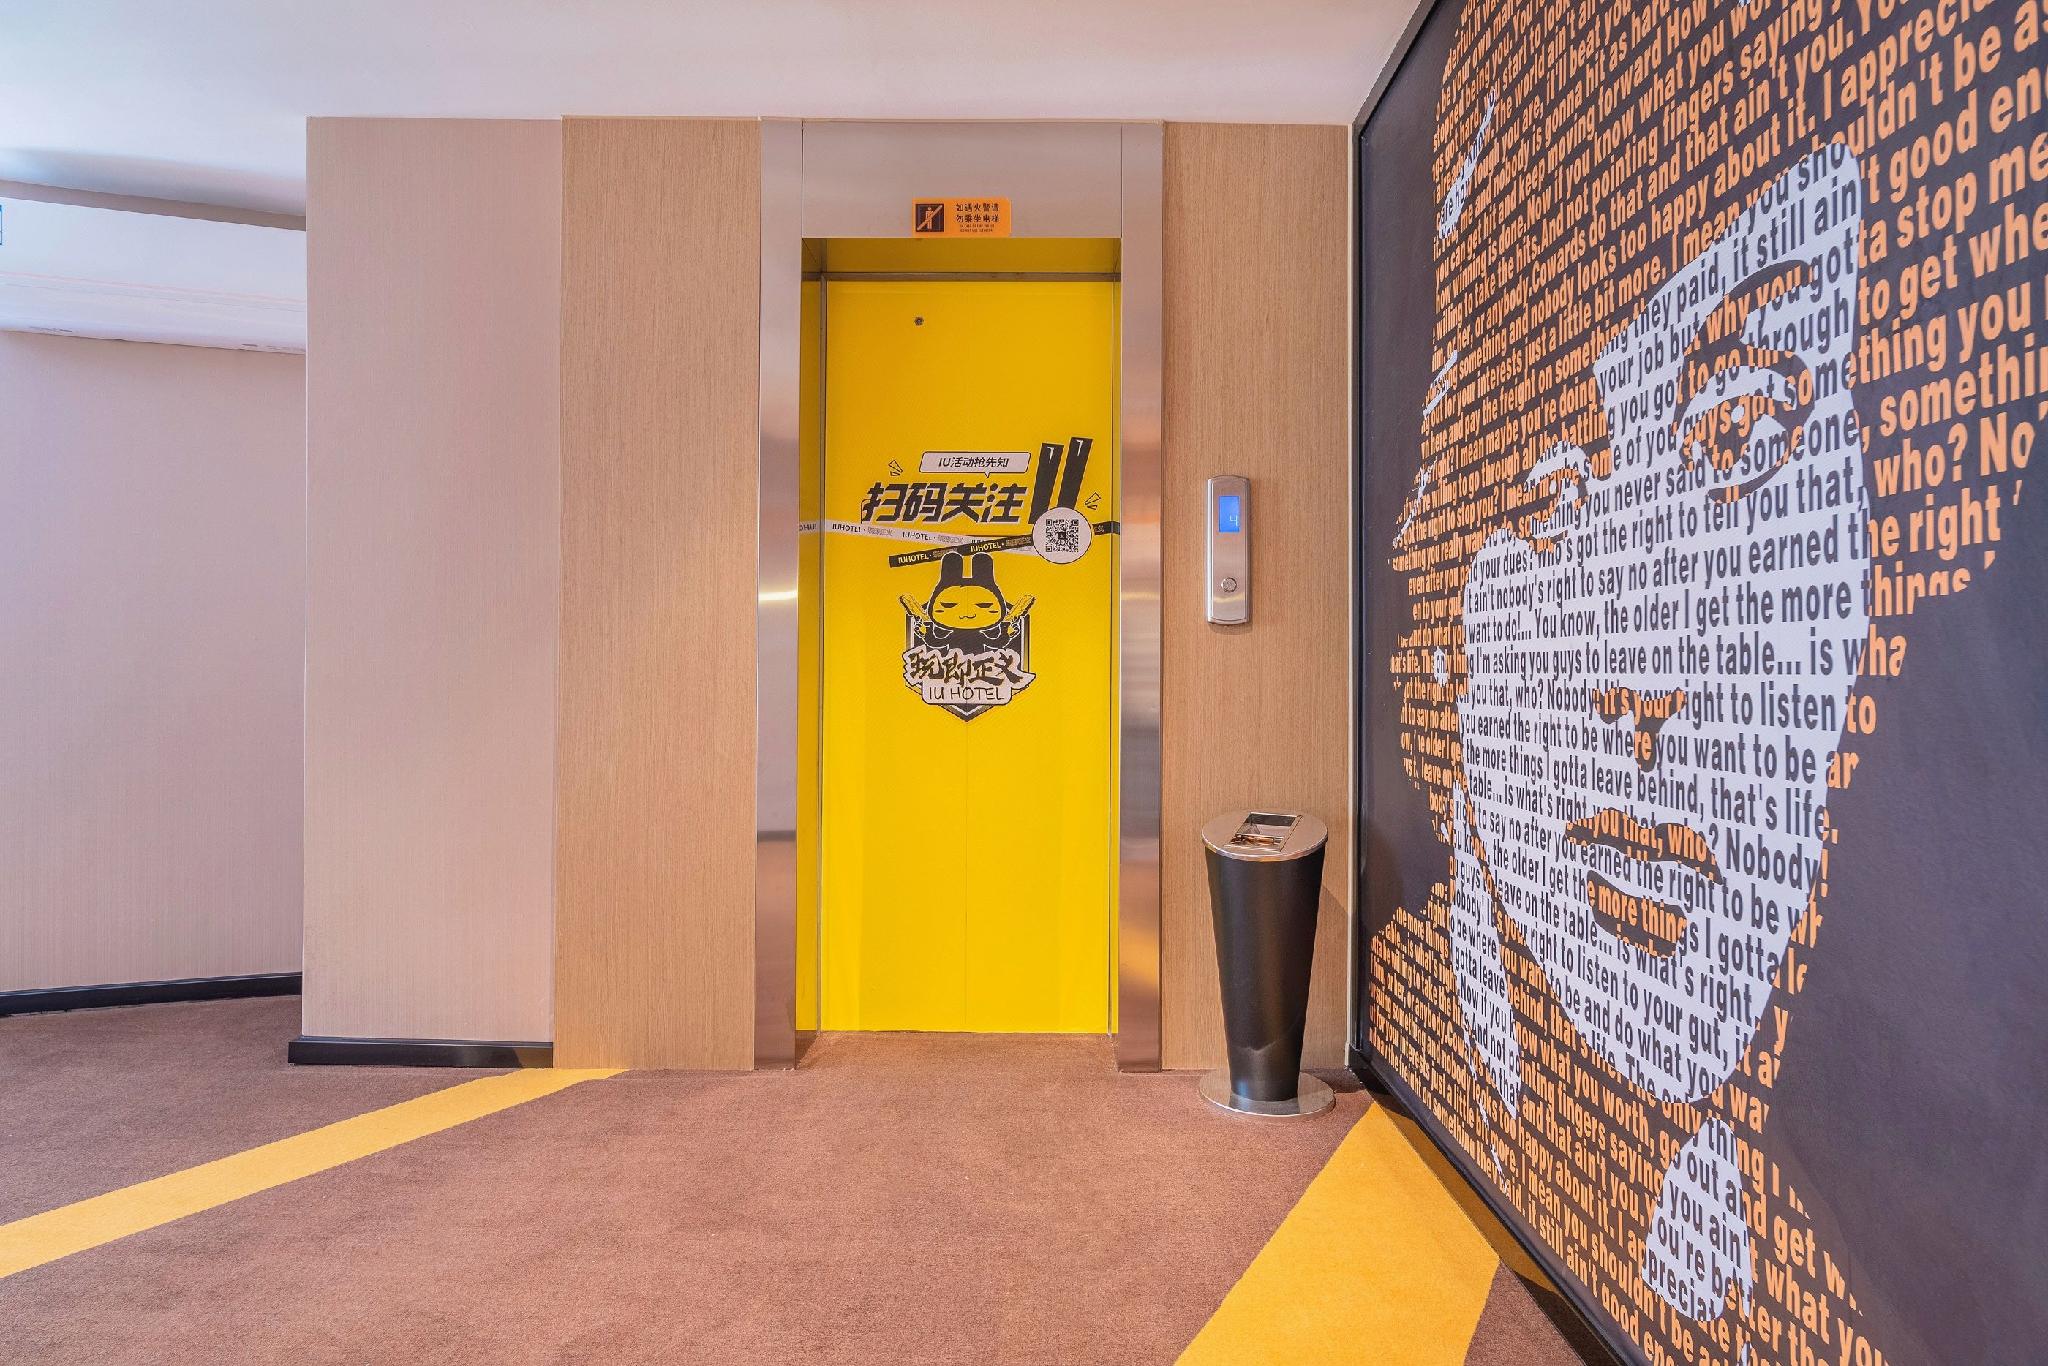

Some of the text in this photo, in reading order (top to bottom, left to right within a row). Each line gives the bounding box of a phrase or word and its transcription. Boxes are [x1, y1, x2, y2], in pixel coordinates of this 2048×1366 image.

[1466, 59, 1489, 109] being
[1472, 26, 1490, 70] own
[1474, 14, 1600, 188] tough are, beat
[1503, 35, 1526, 91] start
[1515, 7, 1574, 108] world ain't
[1493, 48, 1605, 198] nobody gonna hit
[1519, 26, 1660, 204] keep moving forward
[1566, 19, 1723, 201] you know what you
[1611, 53, 1787, 232] that and that ain't
[1459, 91, 1815, 380] something and nobody looks too happy about it.
[1475, 58, 1733, 308] take not pointing fingers
[1477, 20, 2001, 397] interests just little bit more. be
[1465, 88, 1976, 441] pay freight paid, still good
[1486, 169, 1976, 454] maybe you're doing your job why stop
[1482, 233, 1957, 486] through all you to get
[1783, 282, 2031, 410] something you
[862, 481, 1028, 524] 扫码关注
[1229, 515, 1239, 526] 4
[1426, 420, 1968, 591] after your got the right you that, who?
[1441, 470, 1660, 561] really never
[1497, 484, 2000, 611] nobody's right say after you earned the right
[1468, 579, 1851, 642] want You know, the older get the more
[1493, 627, 1831, 680] asking guys leave is
[929, 687, 1005, 701] IU HOTEL
[1478, 710, 1815, 783] earned right you want to be
[1516, 678, 1876, 732] who? to listen to
[1482, 746, 1837, 843] more gotta leave behind, that's life.
[1516, 780, 1829, 905] what's Nobody!
[1490, 811, 1715, 914] say after right
[1495, 869, 1559, 928] leave the
[1512, 846, 1780, 987] older get more gotta
[1407, 913, 1546, 1034] more behind,
[1531, 922, 1728, 1070] right listen your gut,
[1584, 994, 1680, 1080] and what
[1519, 1115, 1593, 1218] happy about
[1529, 1167, 1558, 1219] mean
[1541, 1038, 1815, 1277] what you worth, out get
[1546, 1108, 1606, 1191] that ain't
[1539, 1213, 1597, 1301] still ain't
[1558, 1079, 1830, 1345] fingers saying you what
